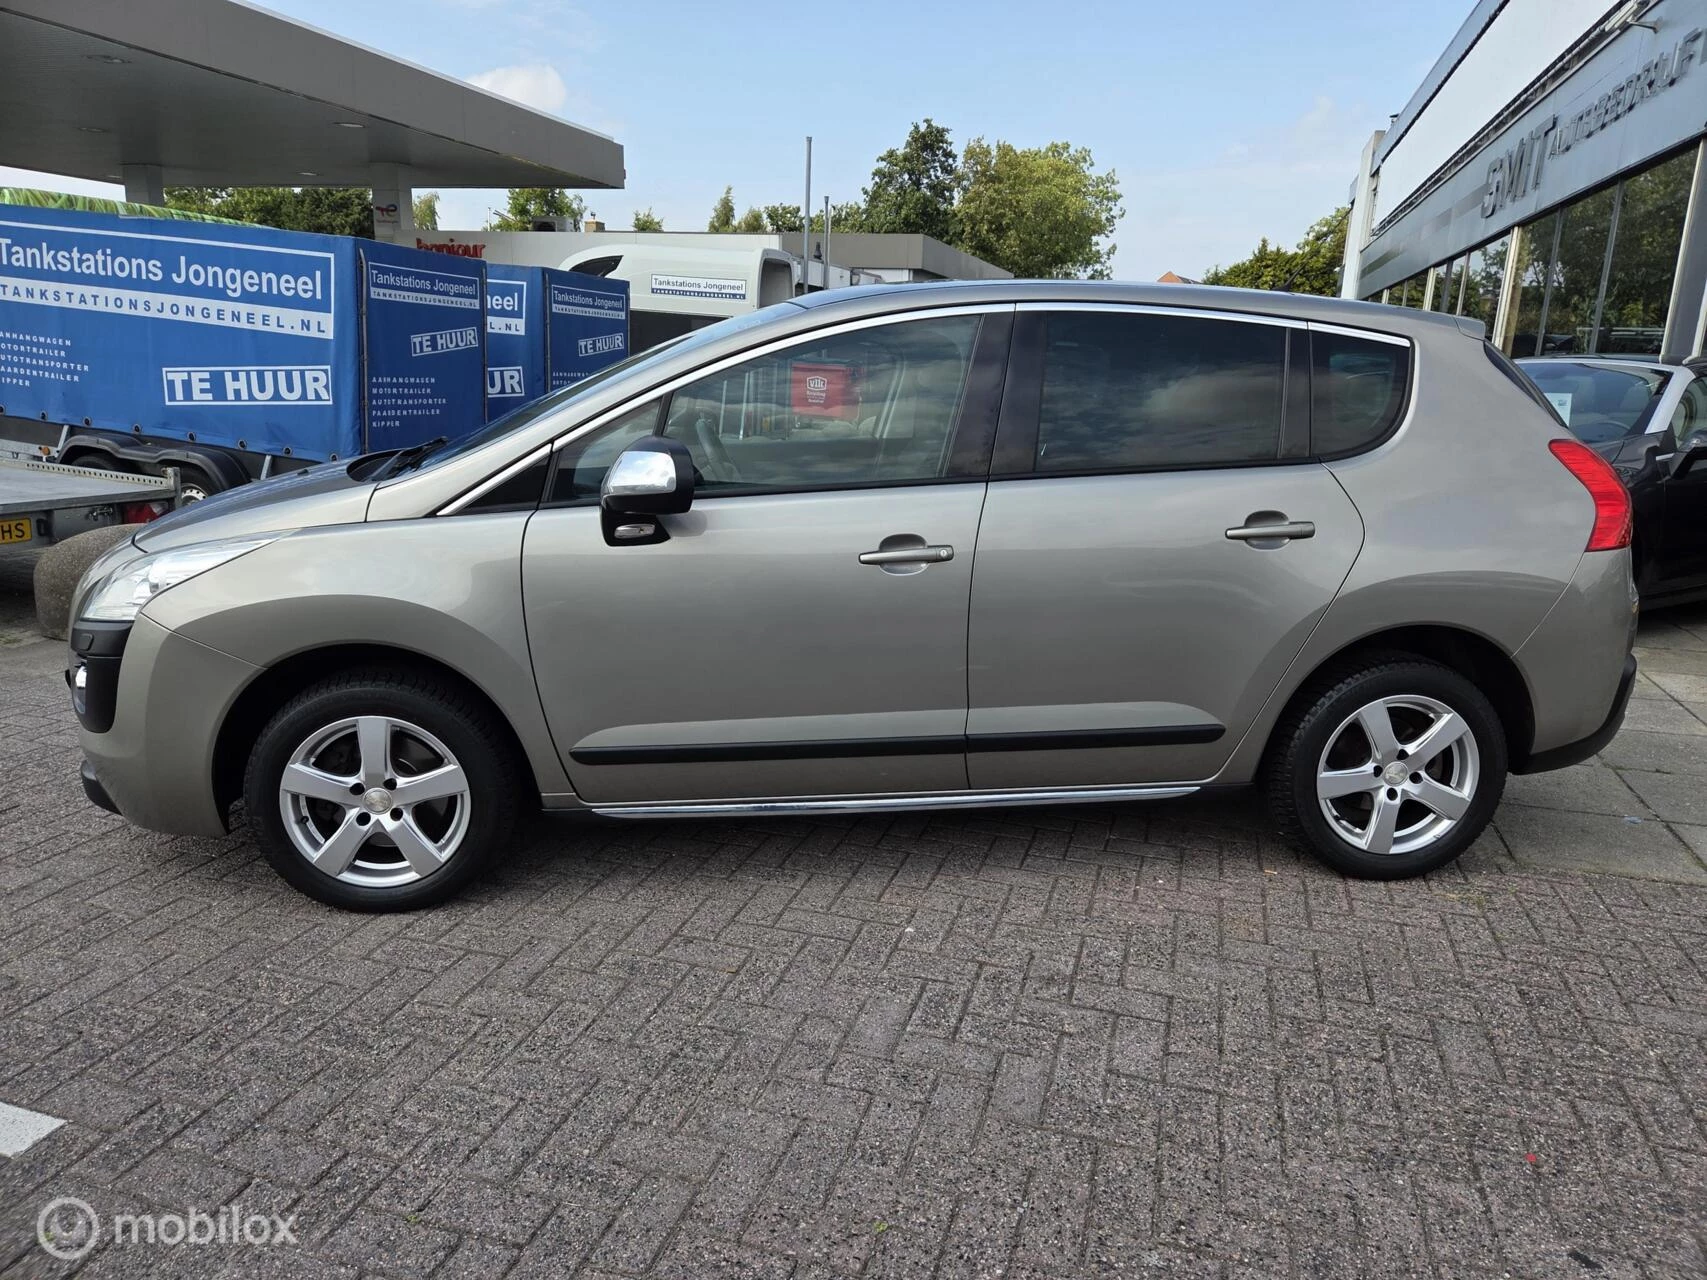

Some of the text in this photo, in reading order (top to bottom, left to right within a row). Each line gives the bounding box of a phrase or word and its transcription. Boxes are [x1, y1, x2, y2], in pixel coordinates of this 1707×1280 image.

[0, 238, 322, 300] Tankstations Jongeneel
[371, 270, 476, 295] Tankstations Jongeneel
[653, 278, 744, 292] Tankstations Jongeneel
[1, 284, 326, 333] TANKSTATIONSJONGENEEL.NL
[554, 290, 623, 309] Tankstations Jongeneel
[412, 330, 476, 353] TE HUUR
[580, 336, 623, 354] TE HUUR
[167, 370, 330, 400] TE HUUR
[1, 522, 25, 540] HS
